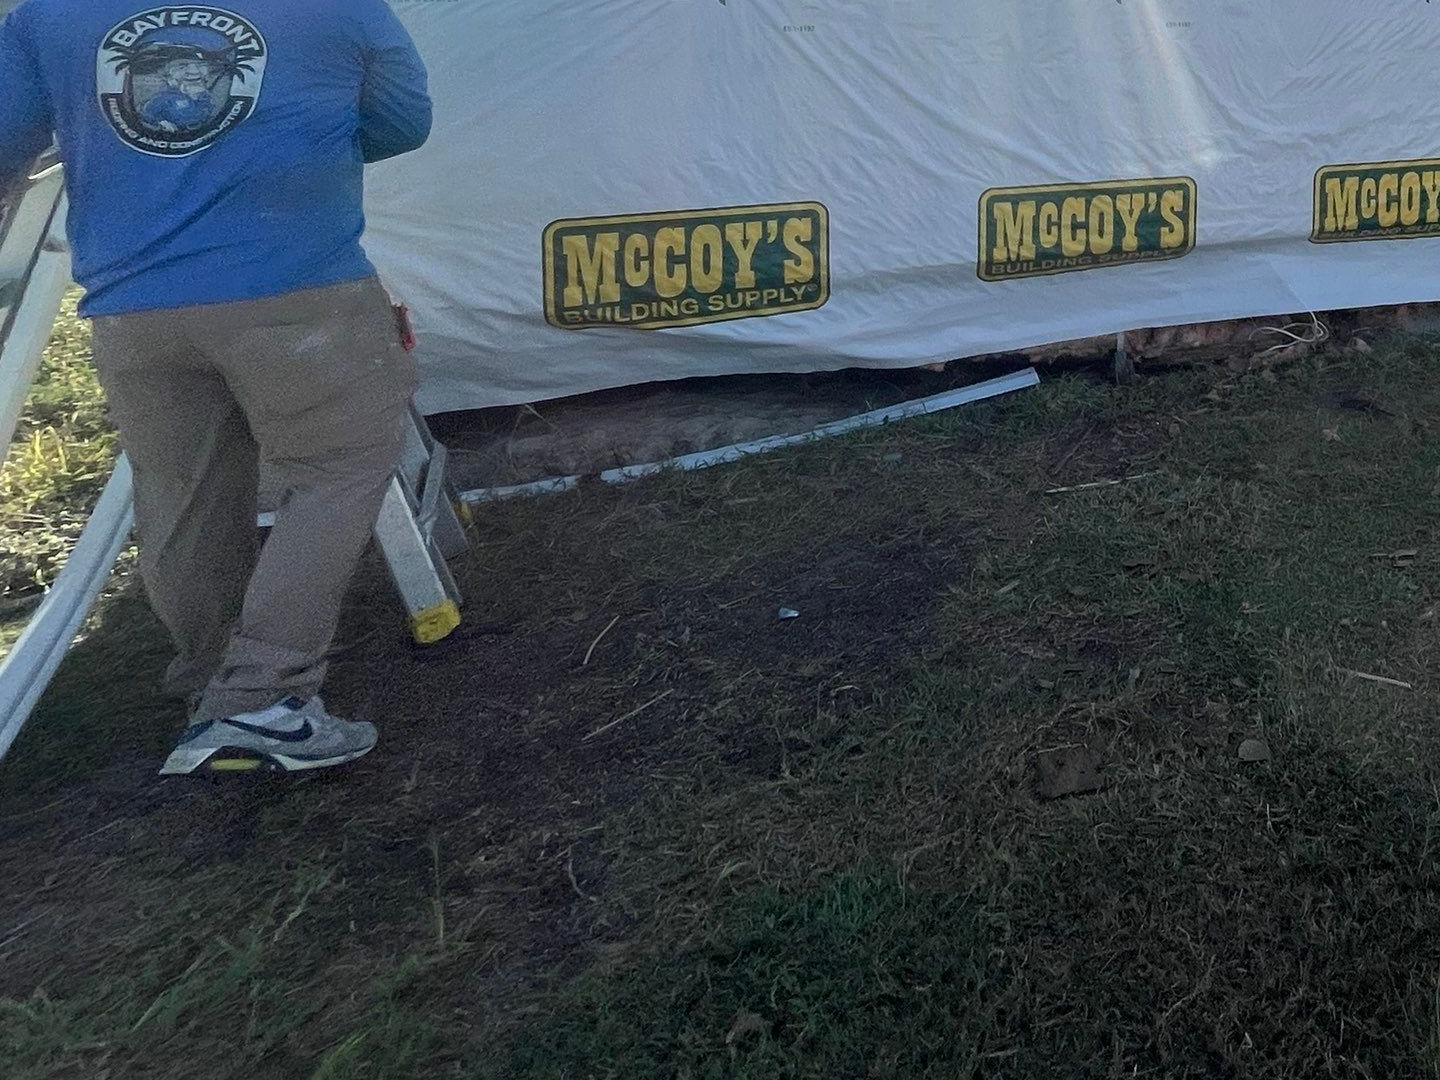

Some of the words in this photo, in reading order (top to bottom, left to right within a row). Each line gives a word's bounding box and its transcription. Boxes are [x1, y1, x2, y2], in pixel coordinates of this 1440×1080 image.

[112, 11, 260, 53] BAYFRONT
[991, 255, 1093, 274] BUILDING
[562, 297, 700, 323] BUILDING
